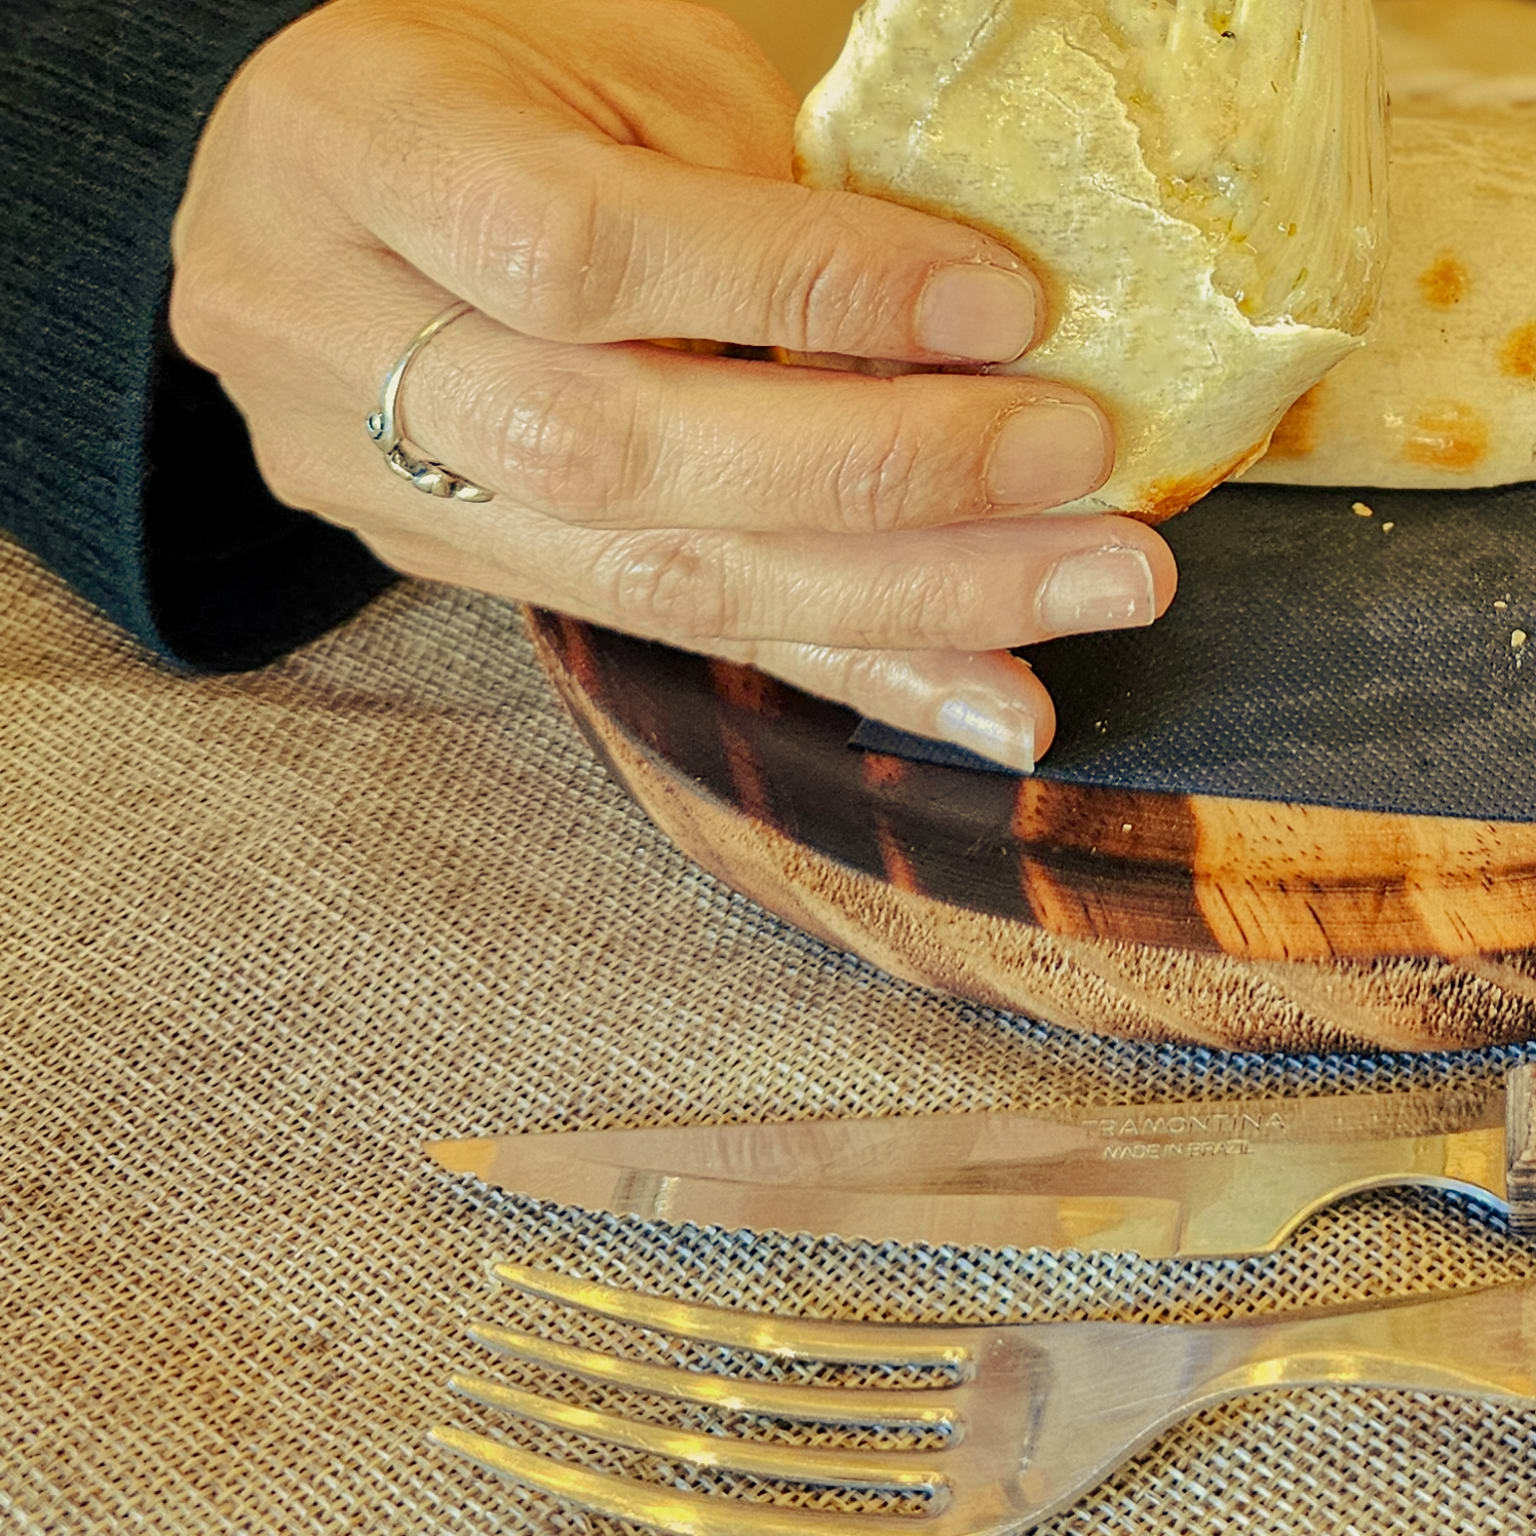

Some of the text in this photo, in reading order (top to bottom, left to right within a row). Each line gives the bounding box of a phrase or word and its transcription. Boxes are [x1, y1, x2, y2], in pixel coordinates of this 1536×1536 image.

[1081, 1112, 1287, 1137] TRAMONTINA
[1103, 1139, 1256, 1160] MADE IN BRAZIL
